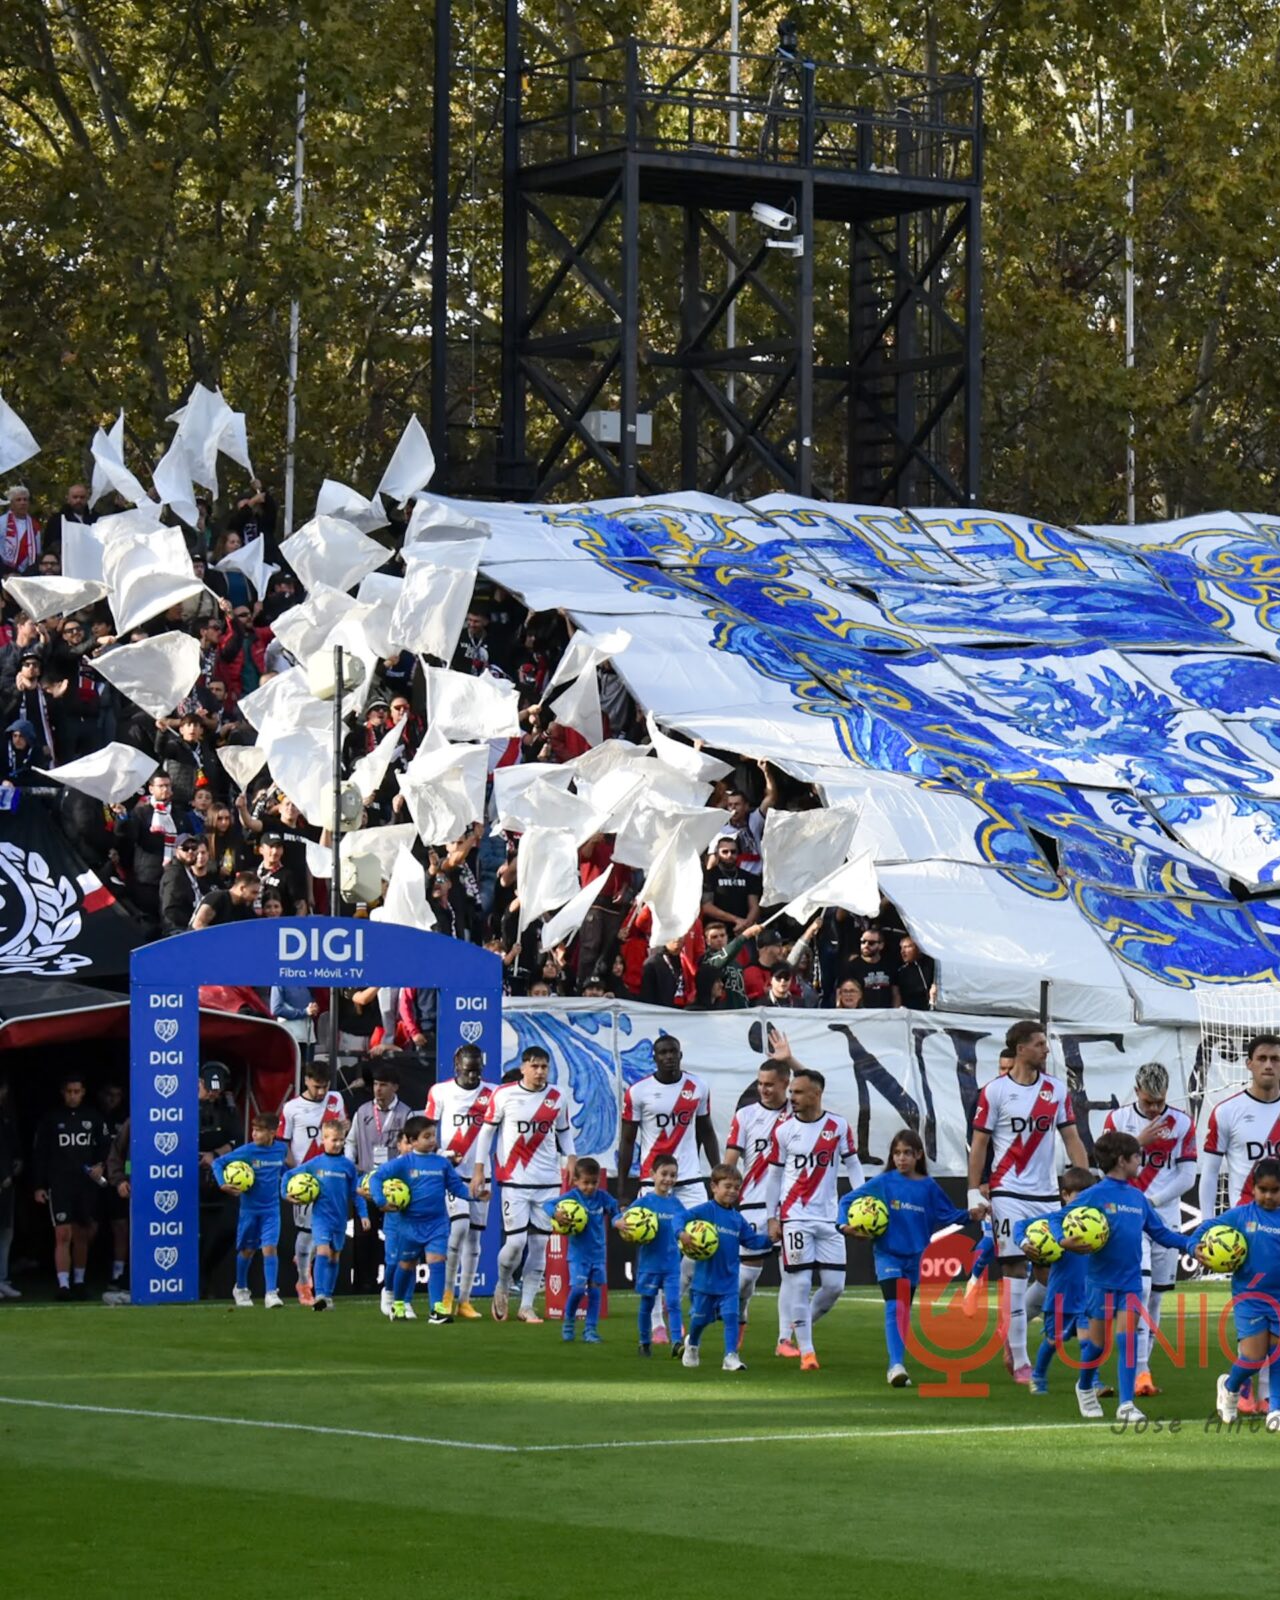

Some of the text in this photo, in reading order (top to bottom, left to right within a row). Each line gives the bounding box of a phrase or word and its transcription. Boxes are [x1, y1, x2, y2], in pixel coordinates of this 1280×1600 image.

[279, 927, 364, 962] DIGI
[279, 967, 363, 978] Fibra Móvil TV
[149, 995, 183, 1008] DIGI
[456, 997, 487, 1010] DIGI
[149, 1051, 183, 1064] DIGI
[149, 1108, 183, 1121] DIGI
[58, 1132, 92, 1147] DIGI
[794, 1151, 835, 1169] DIGI
[1141, 1150, 1172, 1170] IGI
[149, 1165, 183, 1178] DIGI
[149, 1222, 183, 1235] DIGI
[789, 1231, 804, 1250] 18
[149, 1279, 183, 1293] DIGI
